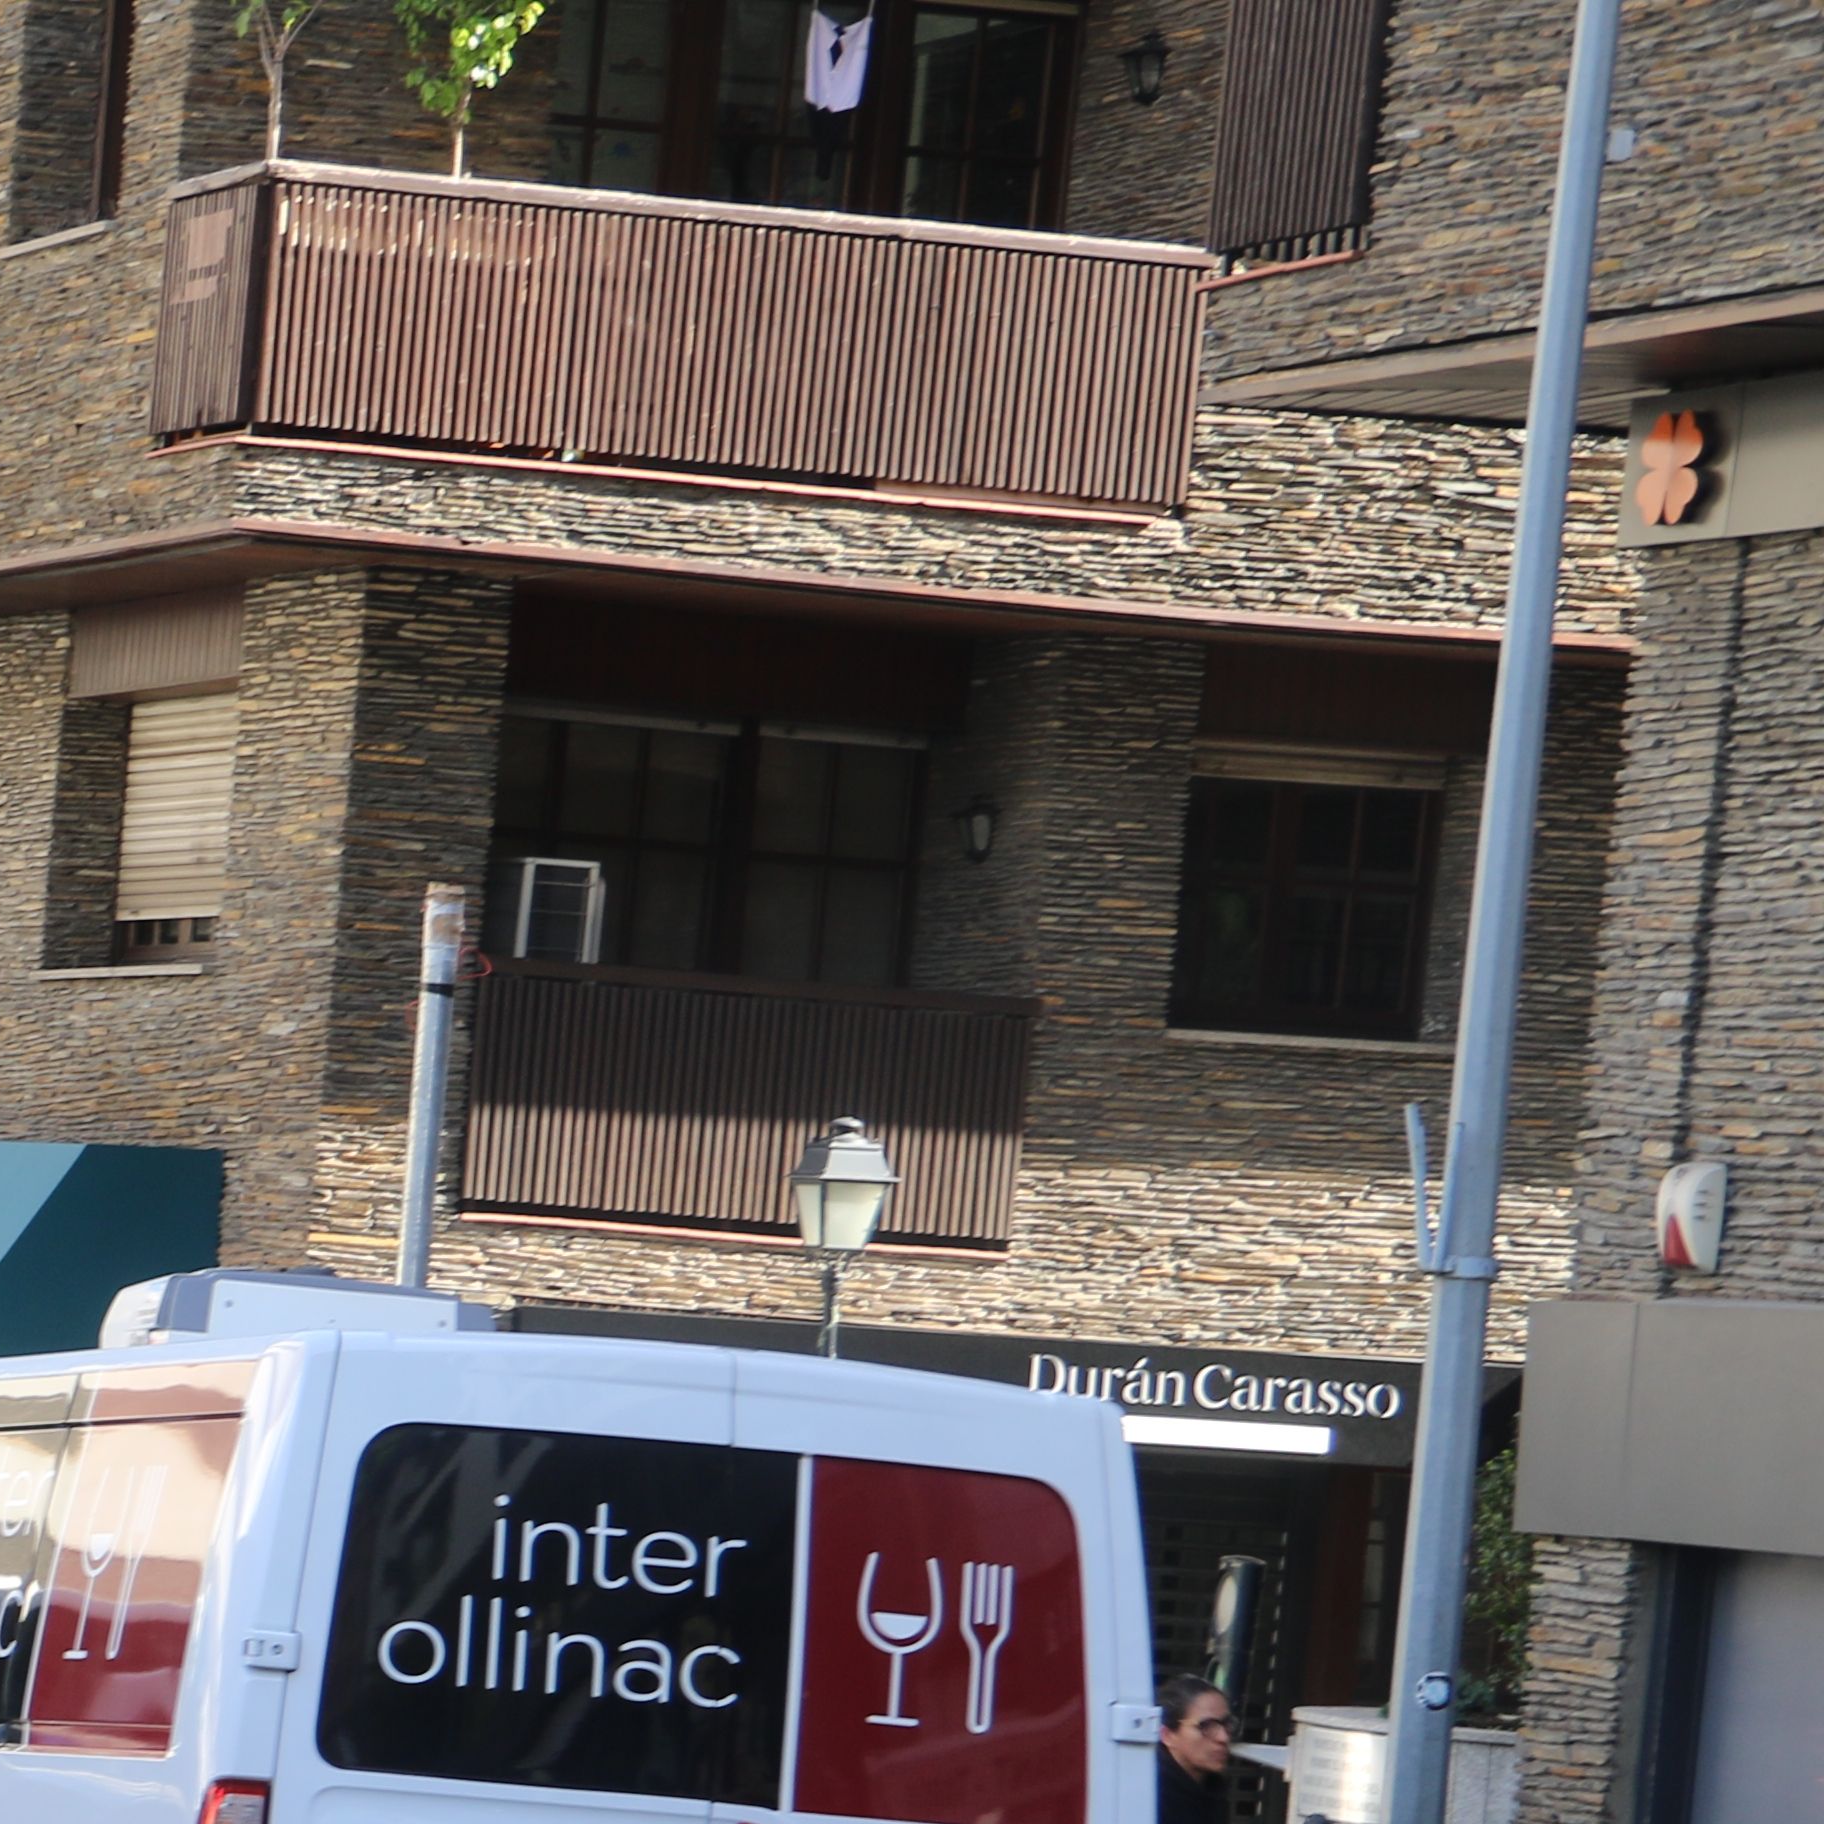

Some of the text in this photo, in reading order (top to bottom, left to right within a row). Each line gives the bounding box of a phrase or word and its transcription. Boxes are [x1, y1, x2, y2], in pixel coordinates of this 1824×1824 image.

[1027, 1353, 1402, 1419] Durán Carasso
[491, 1494, 747, 1598] inter
[378, 1594, 741, 1708] ollinac
